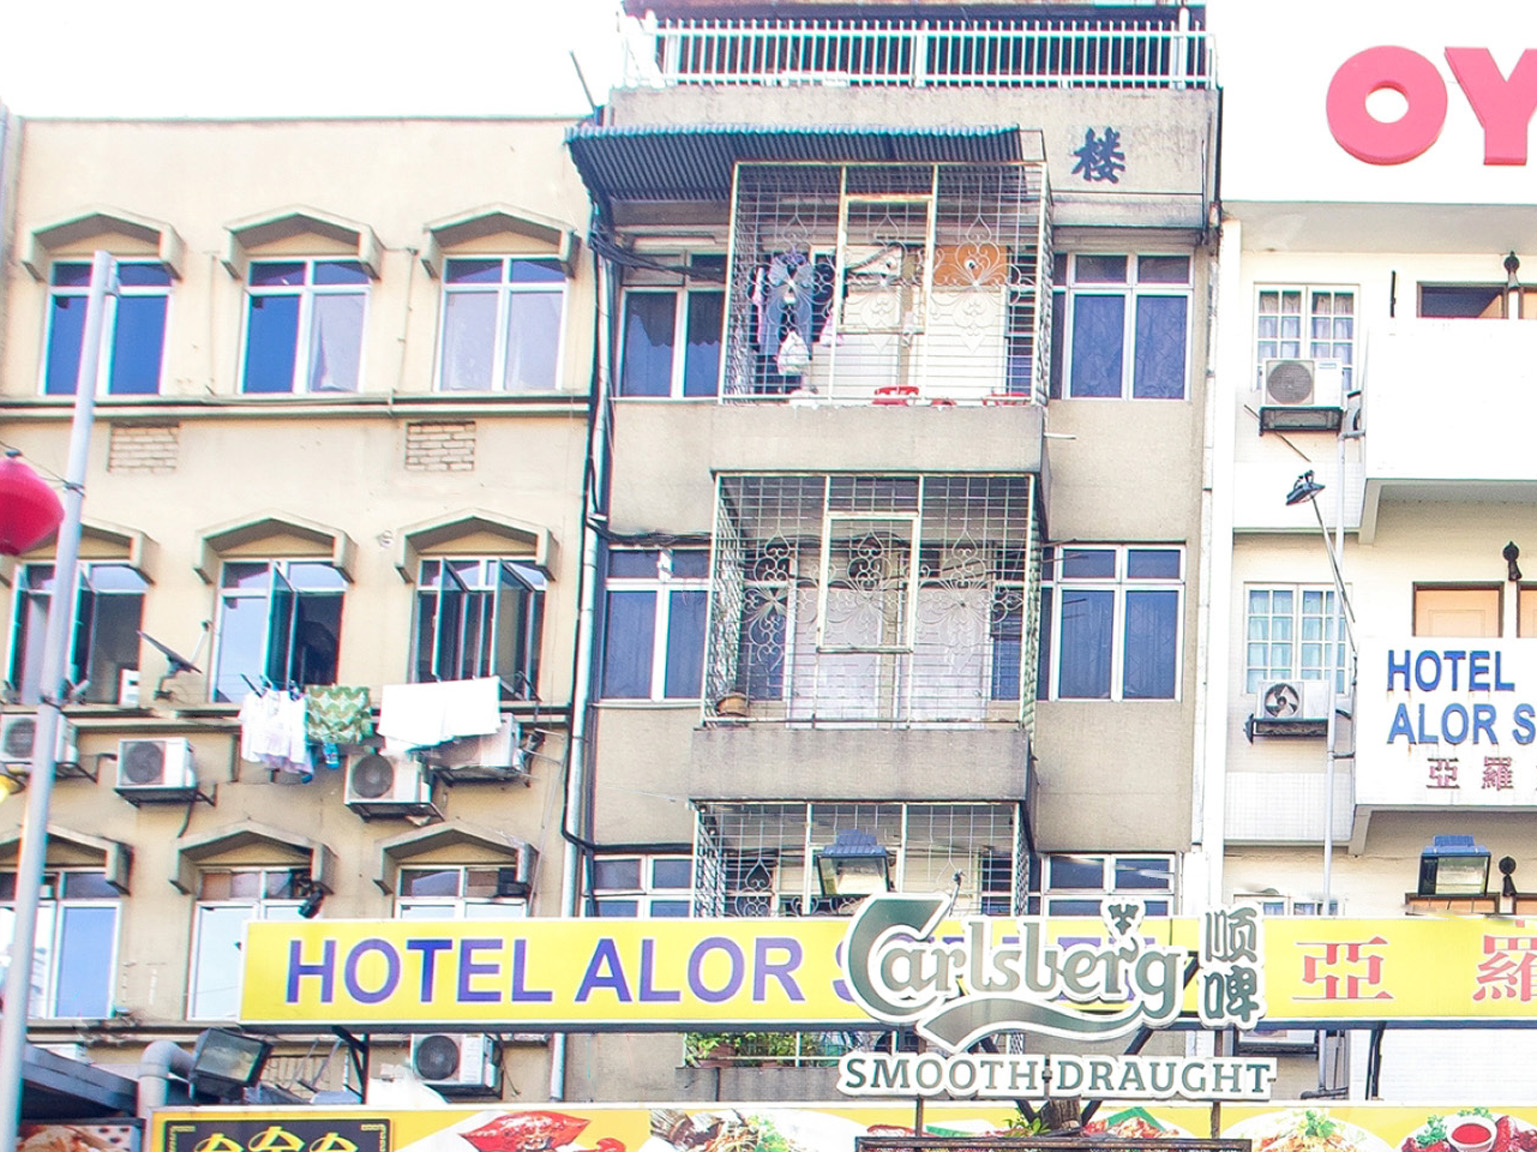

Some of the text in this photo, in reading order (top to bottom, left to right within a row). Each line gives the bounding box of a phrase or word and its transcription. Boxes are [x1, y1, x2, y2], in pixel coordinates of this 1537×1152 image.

[1071, 126, 1125, 184] 楼
[1387, 650, 1515, 692] HOTEL
[1387, 703, 1499, 746] ALOR
[286, 937, 553, 1003] HOTEL
[575, 937, 805, 1003] ALOR
[848, 898, 1182, 1018] Carlsberg
[1204, 907, 1258, 1021] 顺啤
[845, 1058, 1272, 1092] SMOOTH DRAUGHT
